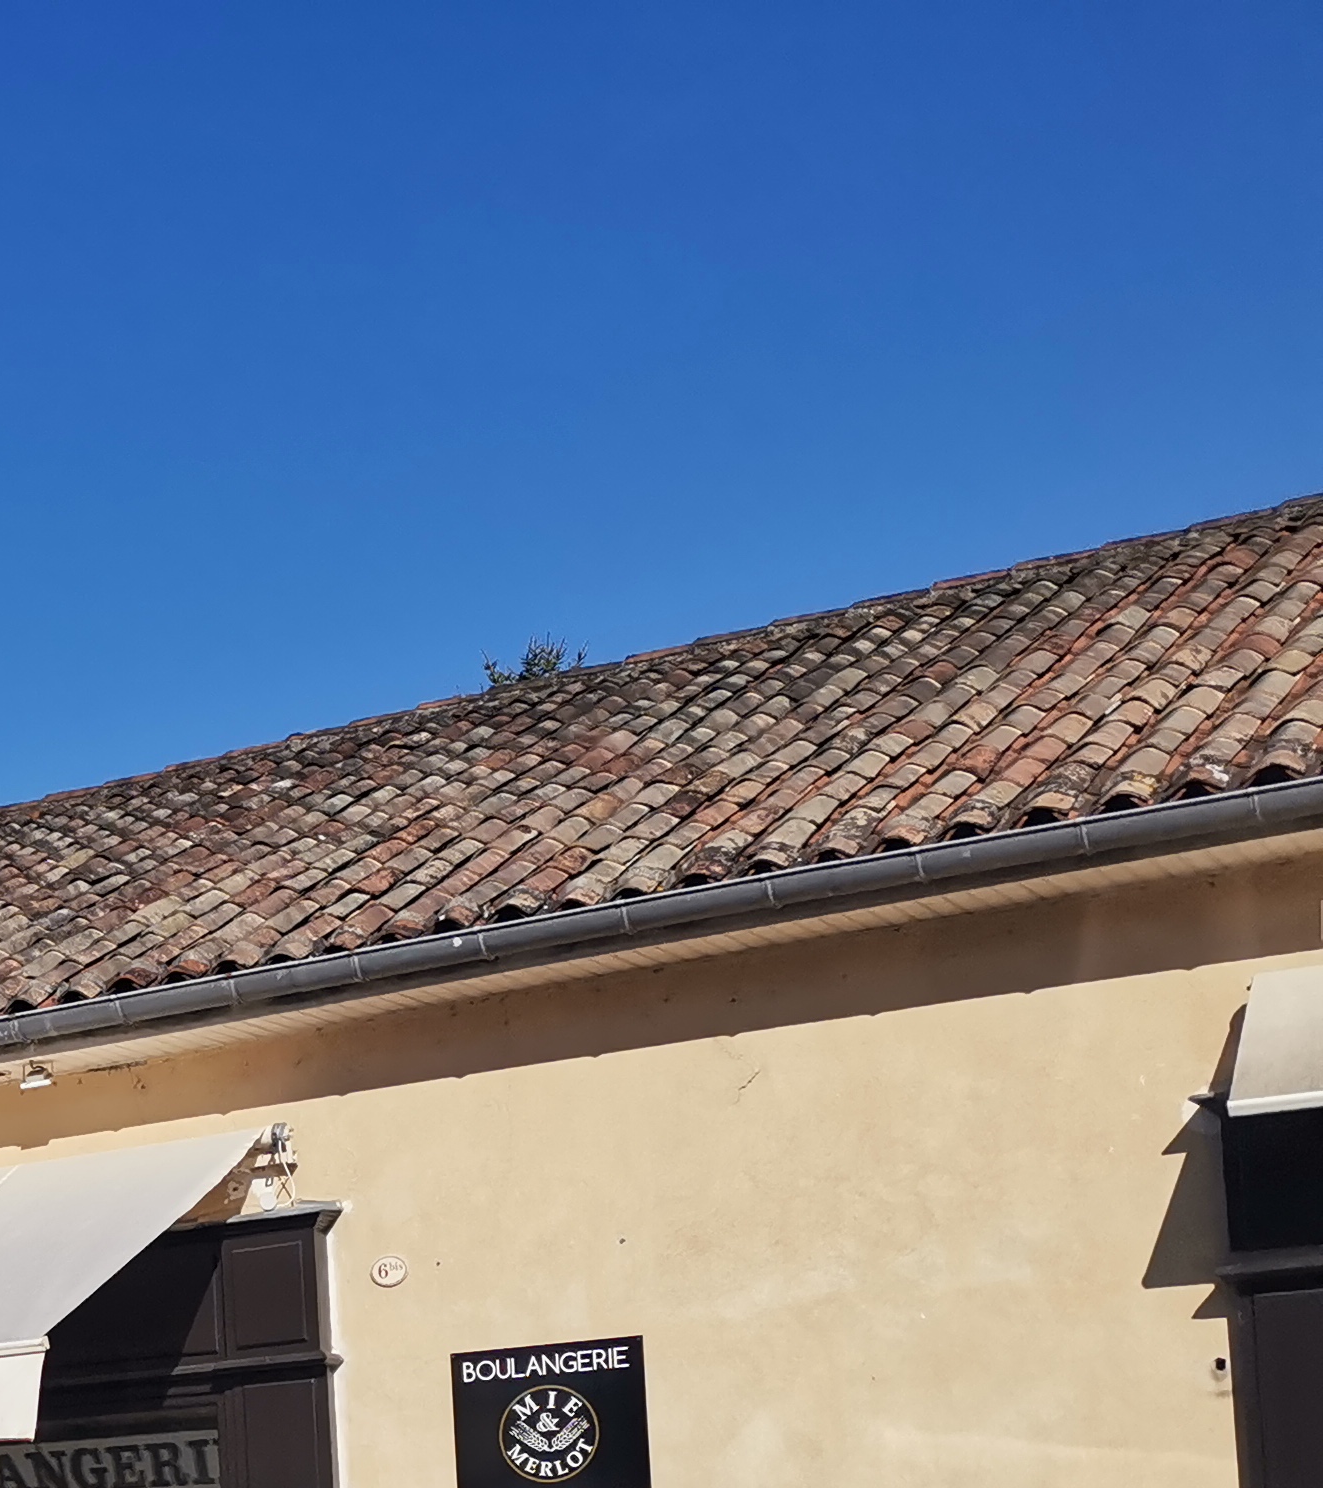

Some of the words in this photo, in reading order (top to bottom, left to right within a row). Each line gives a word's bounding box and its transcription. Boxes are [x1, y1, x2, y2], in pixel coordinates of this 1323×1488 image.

[462, 1346, 630, 1383] BOULANGERIE
[512, 1391, 582, 1421] MIE
[536, 1412, 560, 1432] &
[507, 1438, 594, 1477] MERLOT
